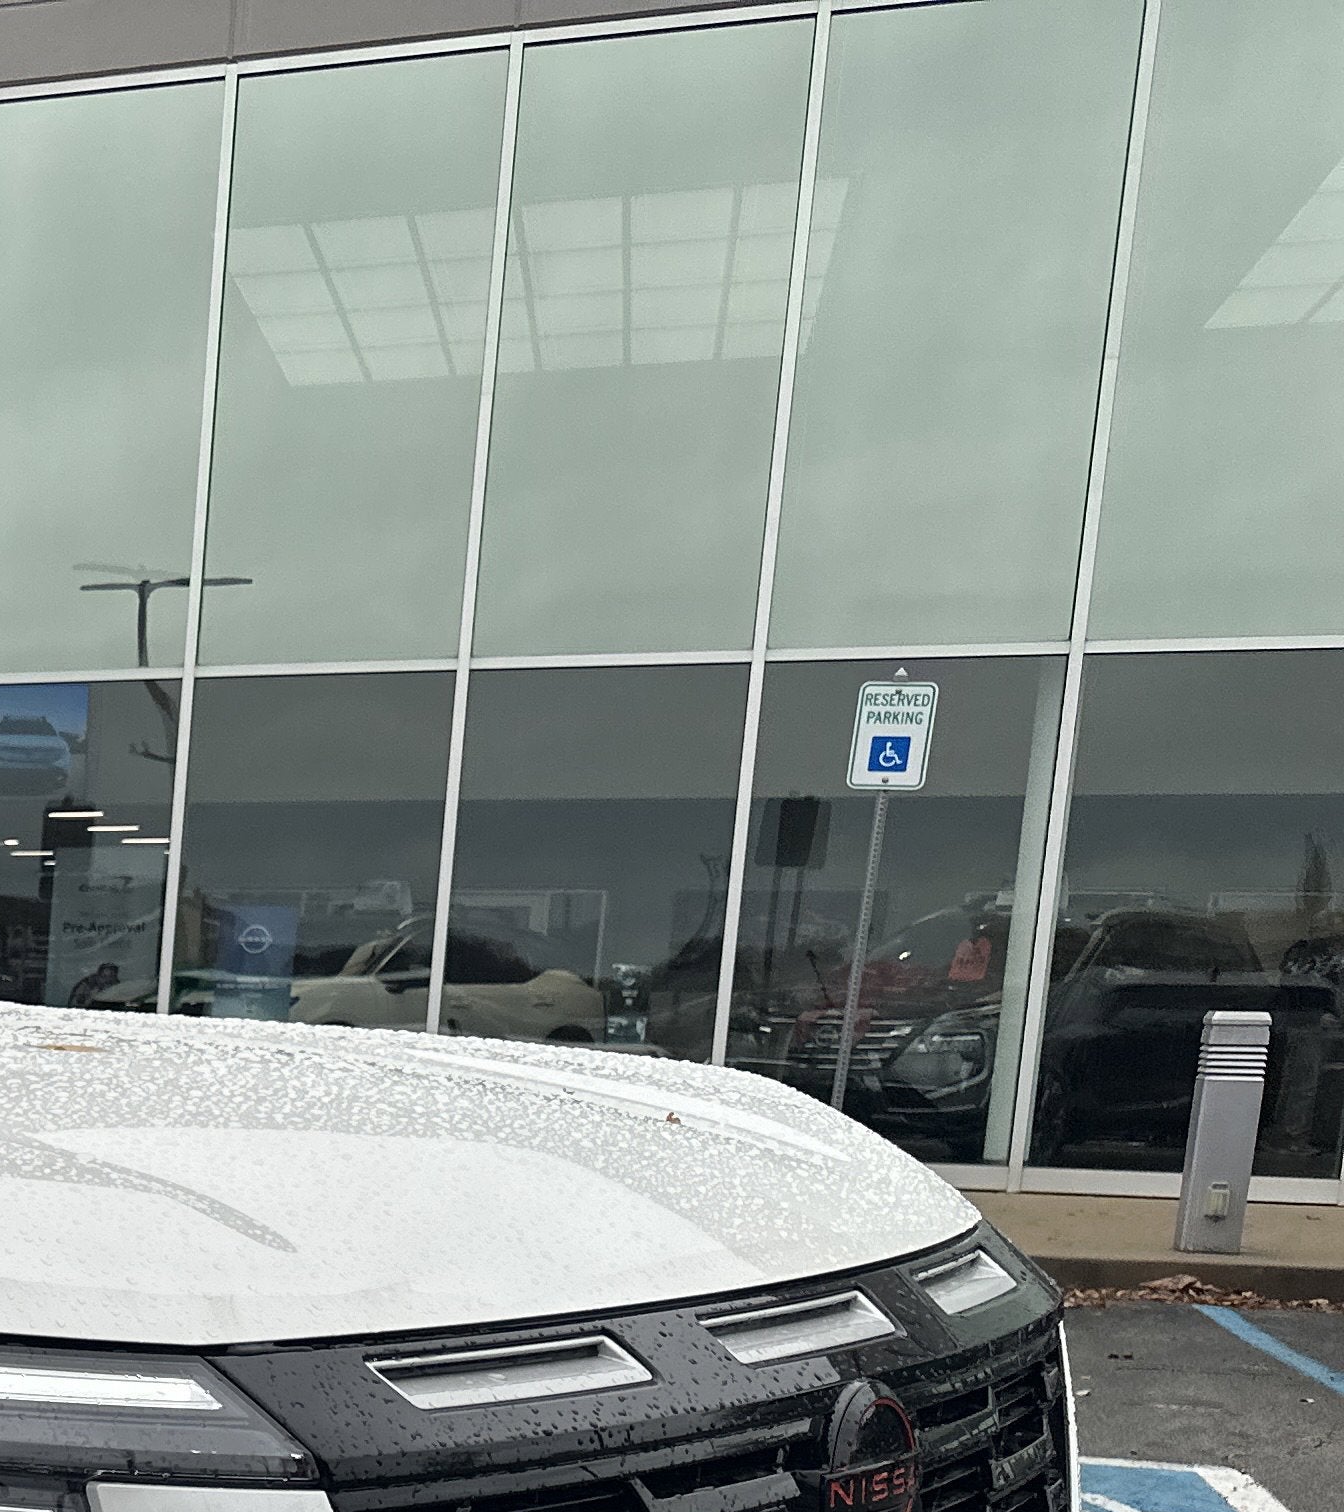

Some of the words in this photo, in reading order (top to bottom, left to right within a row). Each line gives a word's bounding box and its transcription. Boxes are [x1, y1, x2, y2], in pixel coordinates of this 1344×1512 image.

[864, 692, 931, 707] RESERVED
[866, 711, 924, 725] PARKING
[828, 1466, 914, 1508] NISS
